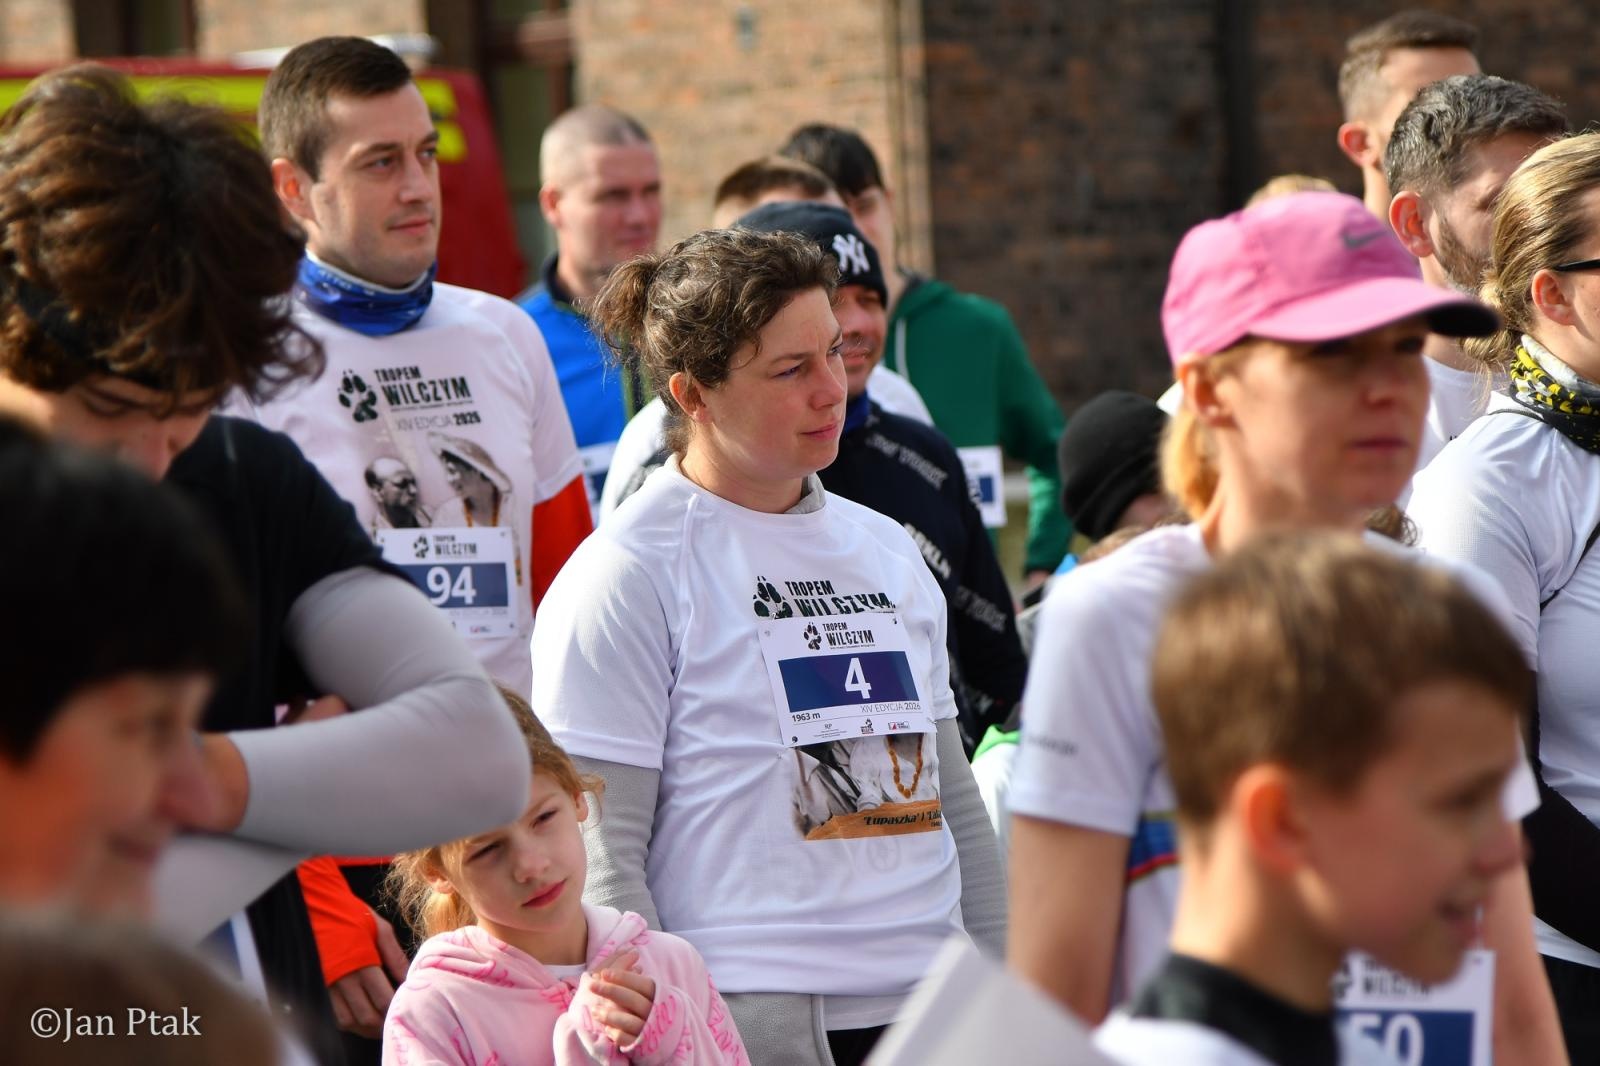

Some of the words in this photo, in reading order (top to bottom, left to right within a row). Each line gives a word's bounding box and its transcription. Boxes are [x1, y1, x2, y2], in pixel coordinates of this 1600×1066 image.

[374, 366, 421, 382] TROPEM
[381, 376, 471, 406] WILCZYM
[427, 566, 477, 606] 94
[785, 580, 835, 596] TROPEM
[794, 592, 893, 617] WILCZYM
[822, 622, 848, 632] TROPEM
[825, 629, 875, 646] WILCZYM
[844, 657, 872, 699] 4
[860, 704, 873, 713] XIV
[874, 703, 904, 712] EDYCJA
[905, 702, 921, 711] 2026
[791, 713, 811, 722] 1963
